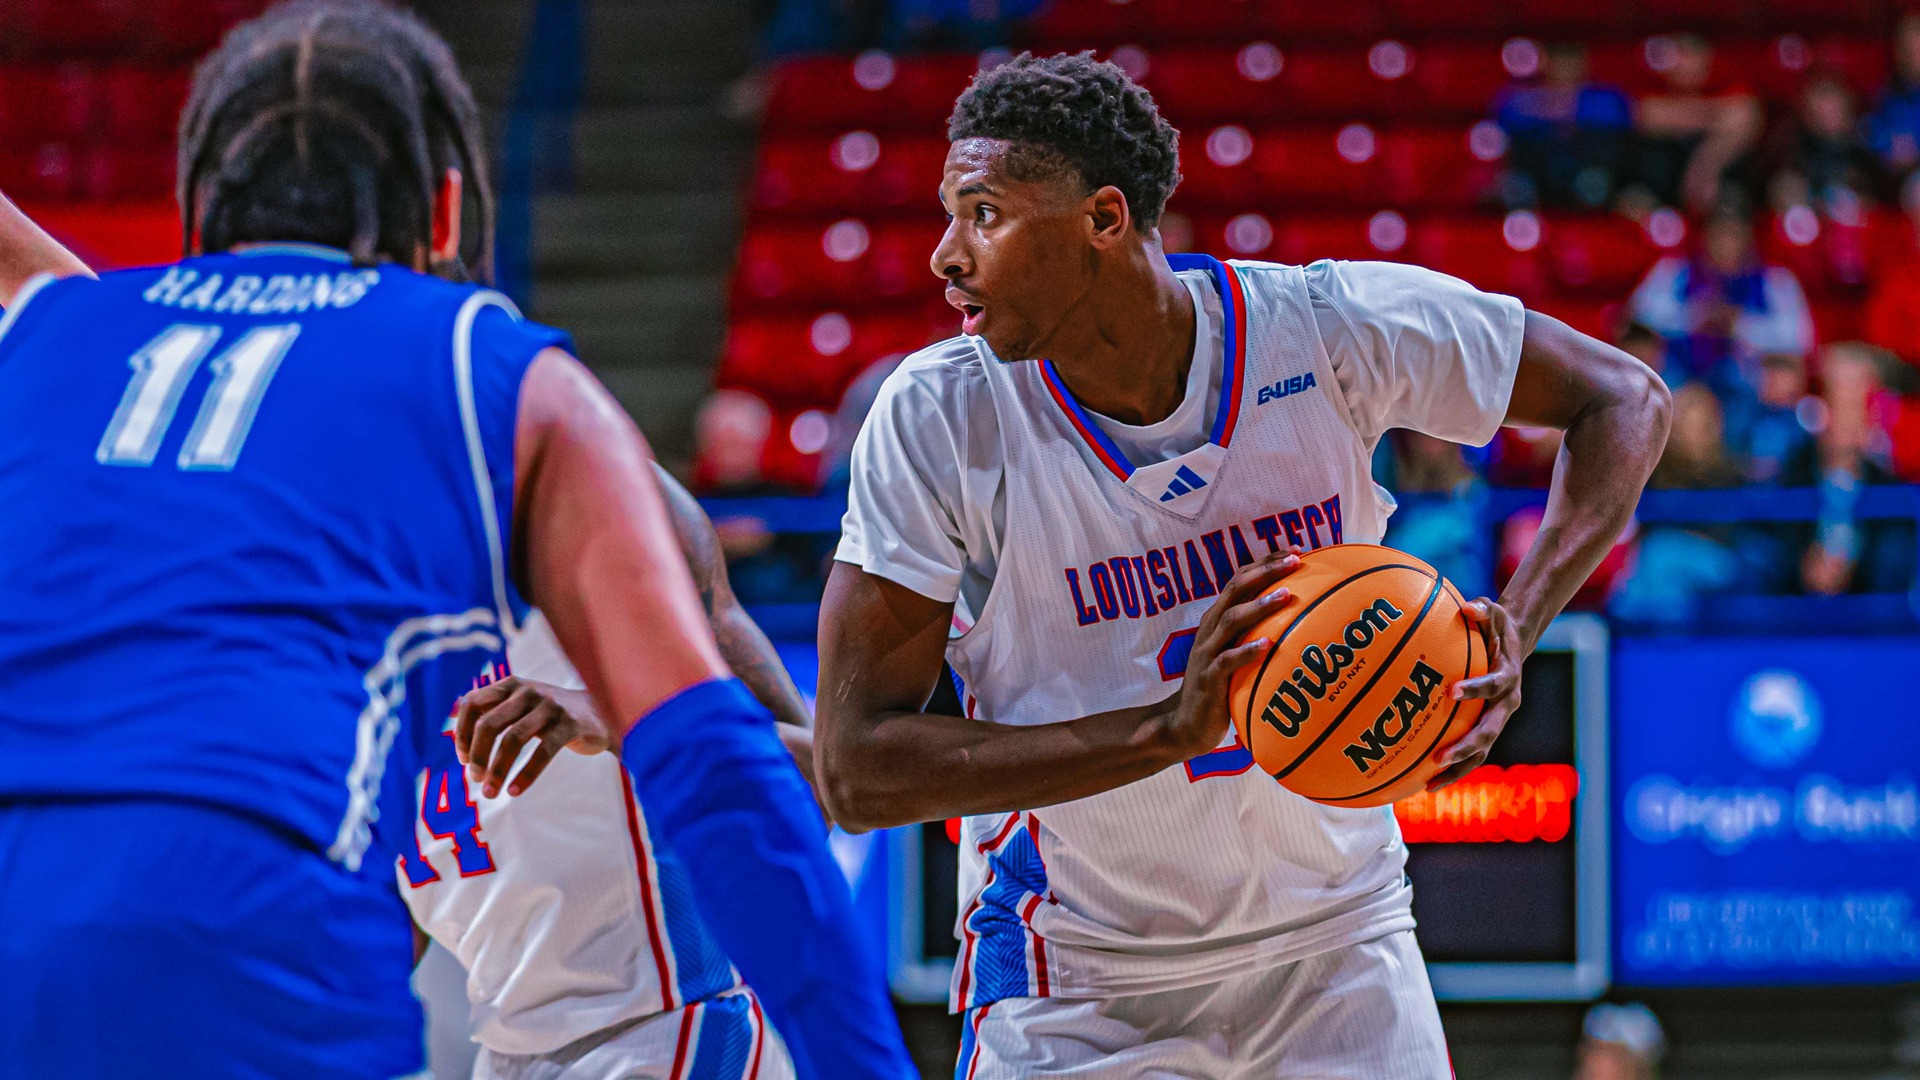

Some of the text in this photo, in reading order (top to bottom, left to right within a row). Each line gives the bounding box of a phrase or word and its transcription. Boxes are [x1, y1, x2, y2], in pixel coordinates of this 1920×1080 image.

[143, 265, 381, 314] HARDING
[95, 321, 302, 472] 11
[1064, 492, 1344, 627] LOUISIANA TECH
[1260, 597, 1404, 738] Wilson
[1327, 657, 1367, 703] EVO NXT
[1343, 658, 1445, 774] NCAA
[1366, 743, 1408, 779] OFFICIAL
[1407, 712, 1433, 743] GAME
